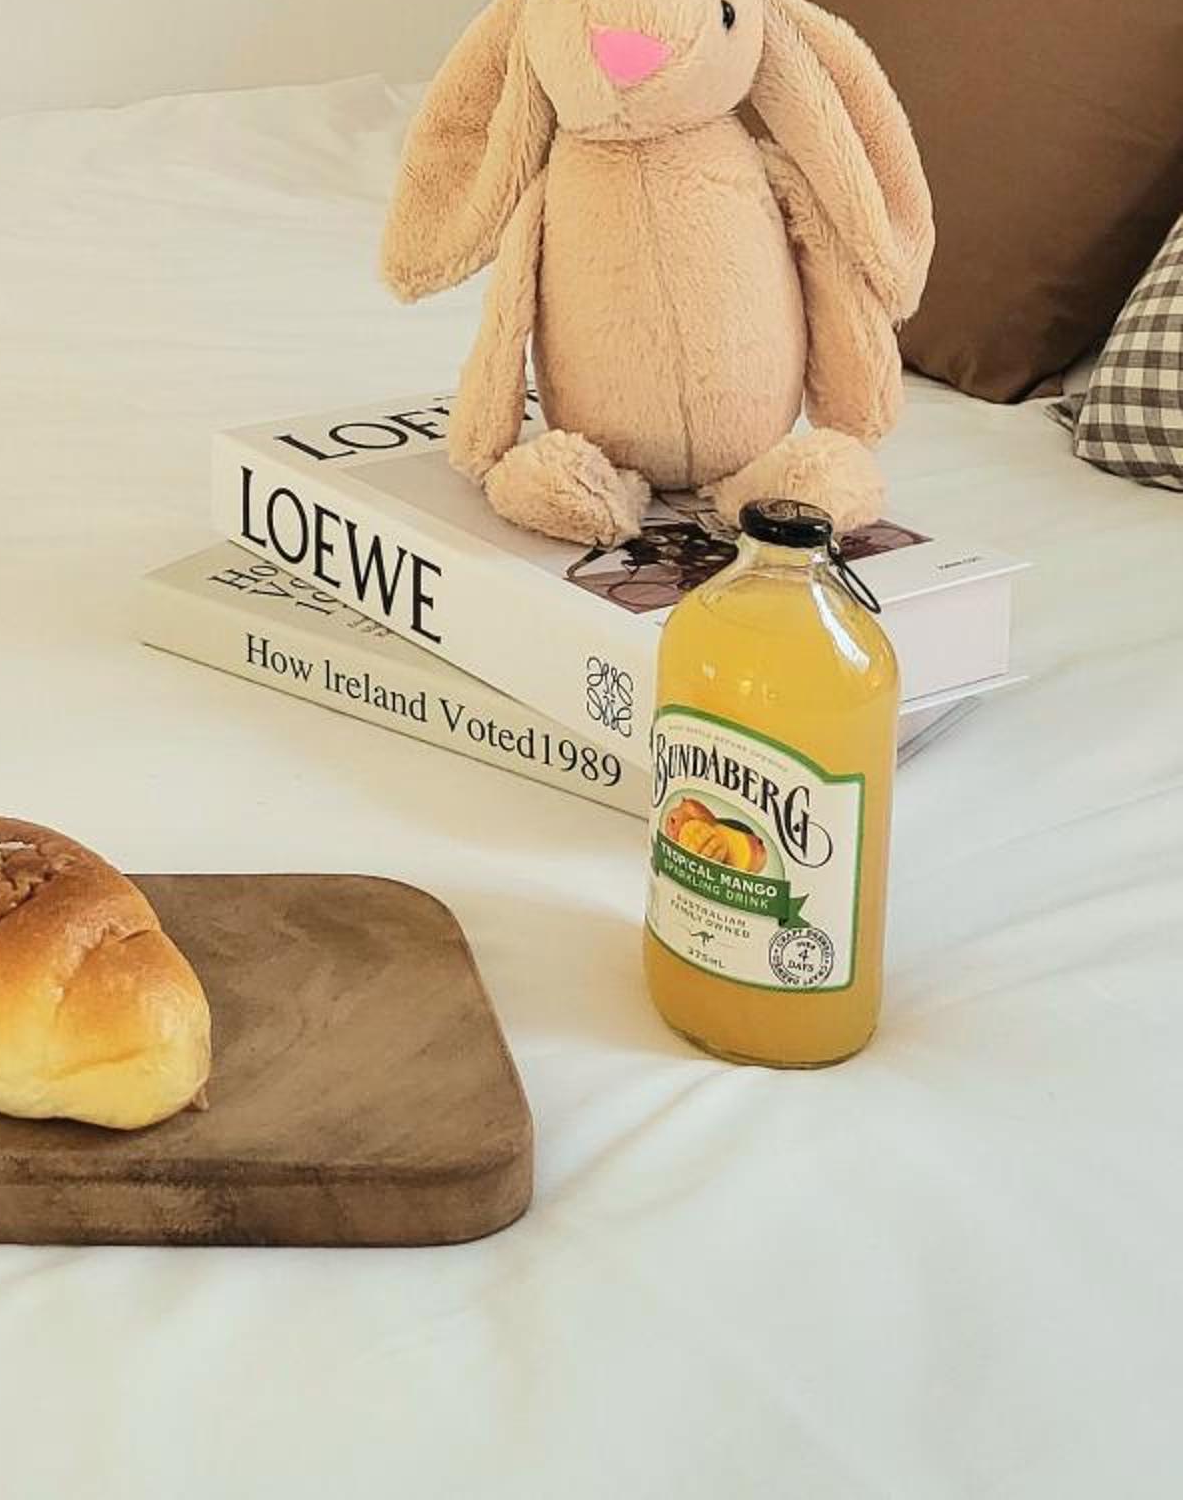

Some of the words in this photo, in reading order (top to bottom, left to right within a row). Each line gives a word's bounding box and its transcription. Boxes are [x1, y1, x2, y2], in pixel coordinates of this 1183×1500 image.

[240, 466, 442, 644] LOEWE
[246, 633, 313, 682] How
[325, 660, 428, 722] Ireland
[651, 730, 831, 865] BUNDABERG
[658, 841, 715, 881] TROPICAL
[720, 873, 777, 897] MANGO
[726, 890, 769, 909] DRINK
[705, 919, 750, 939] OWNED
